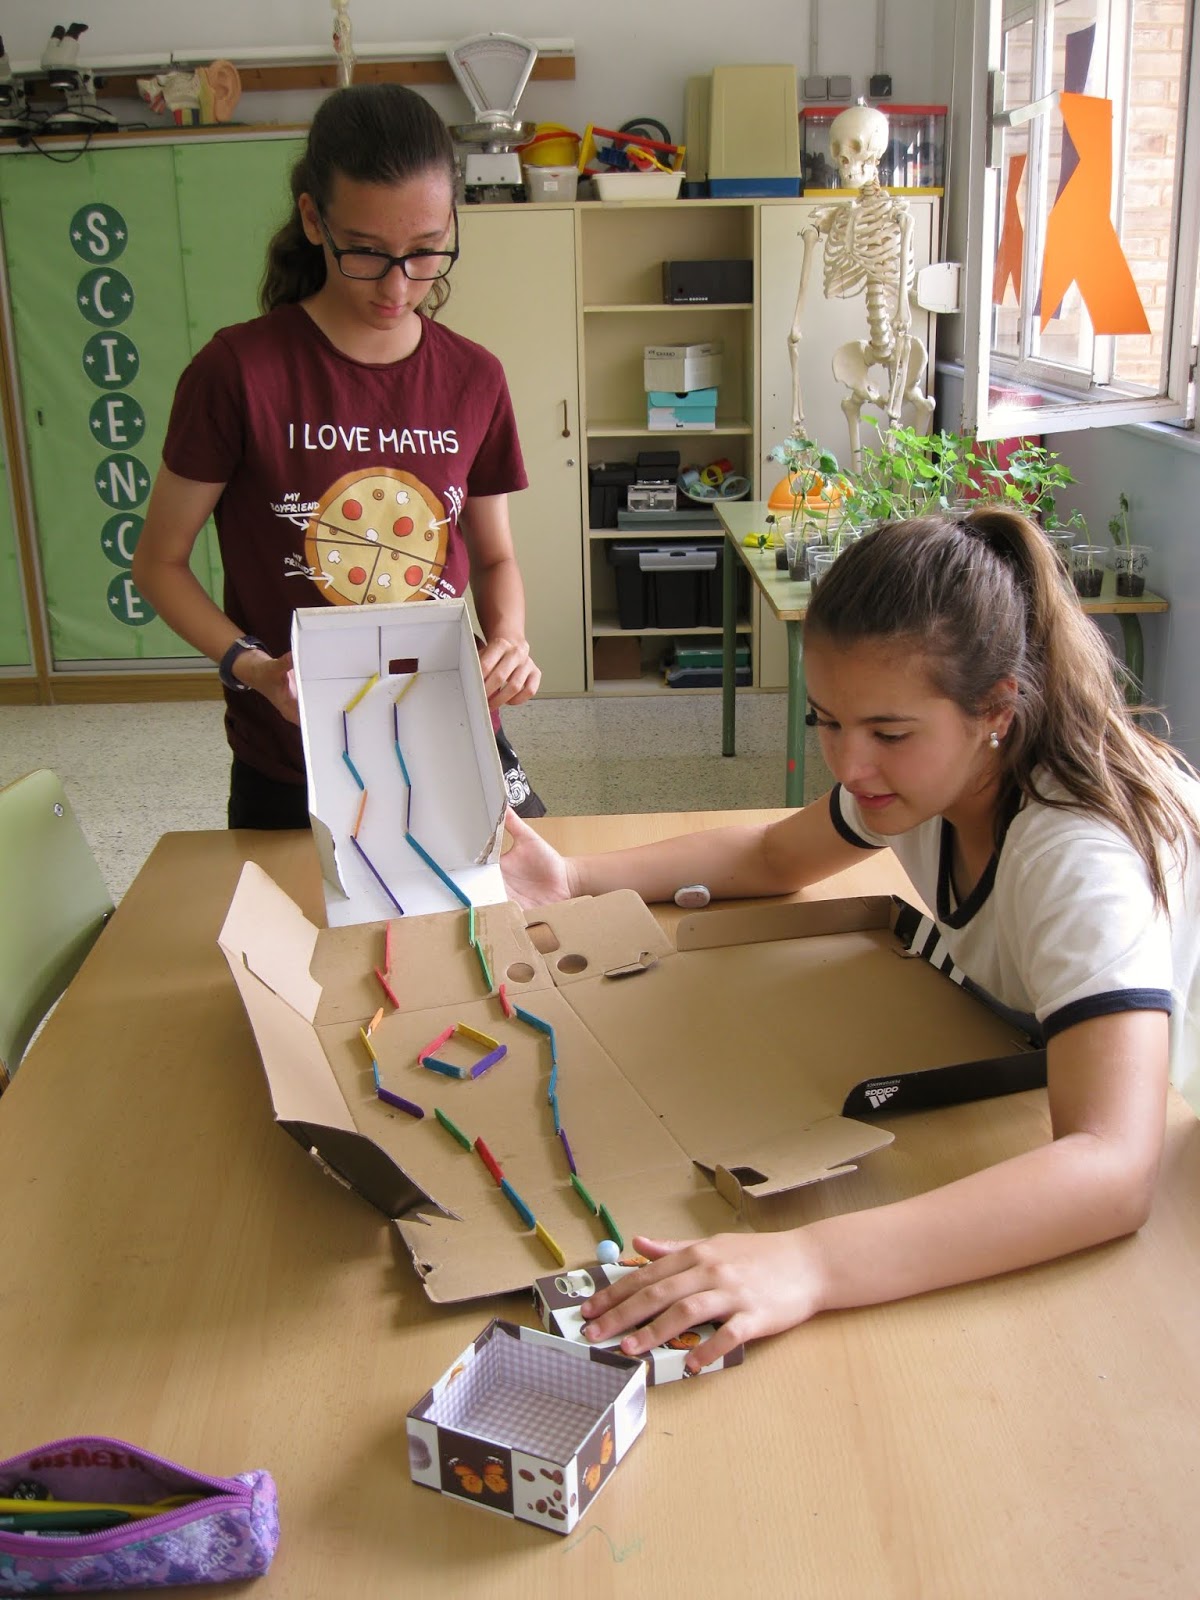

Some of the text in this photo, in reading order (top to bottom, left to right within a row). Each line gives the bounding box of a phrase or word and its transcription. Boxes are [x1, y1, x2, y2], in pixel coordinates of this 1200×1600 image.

[87, 211, 144, 619] SCIENCE
[289, 423, 459, 454] I LOVE MATHS
[283, 492, 301, 502] MY
[864, 1085, 899, 1097] adidas
